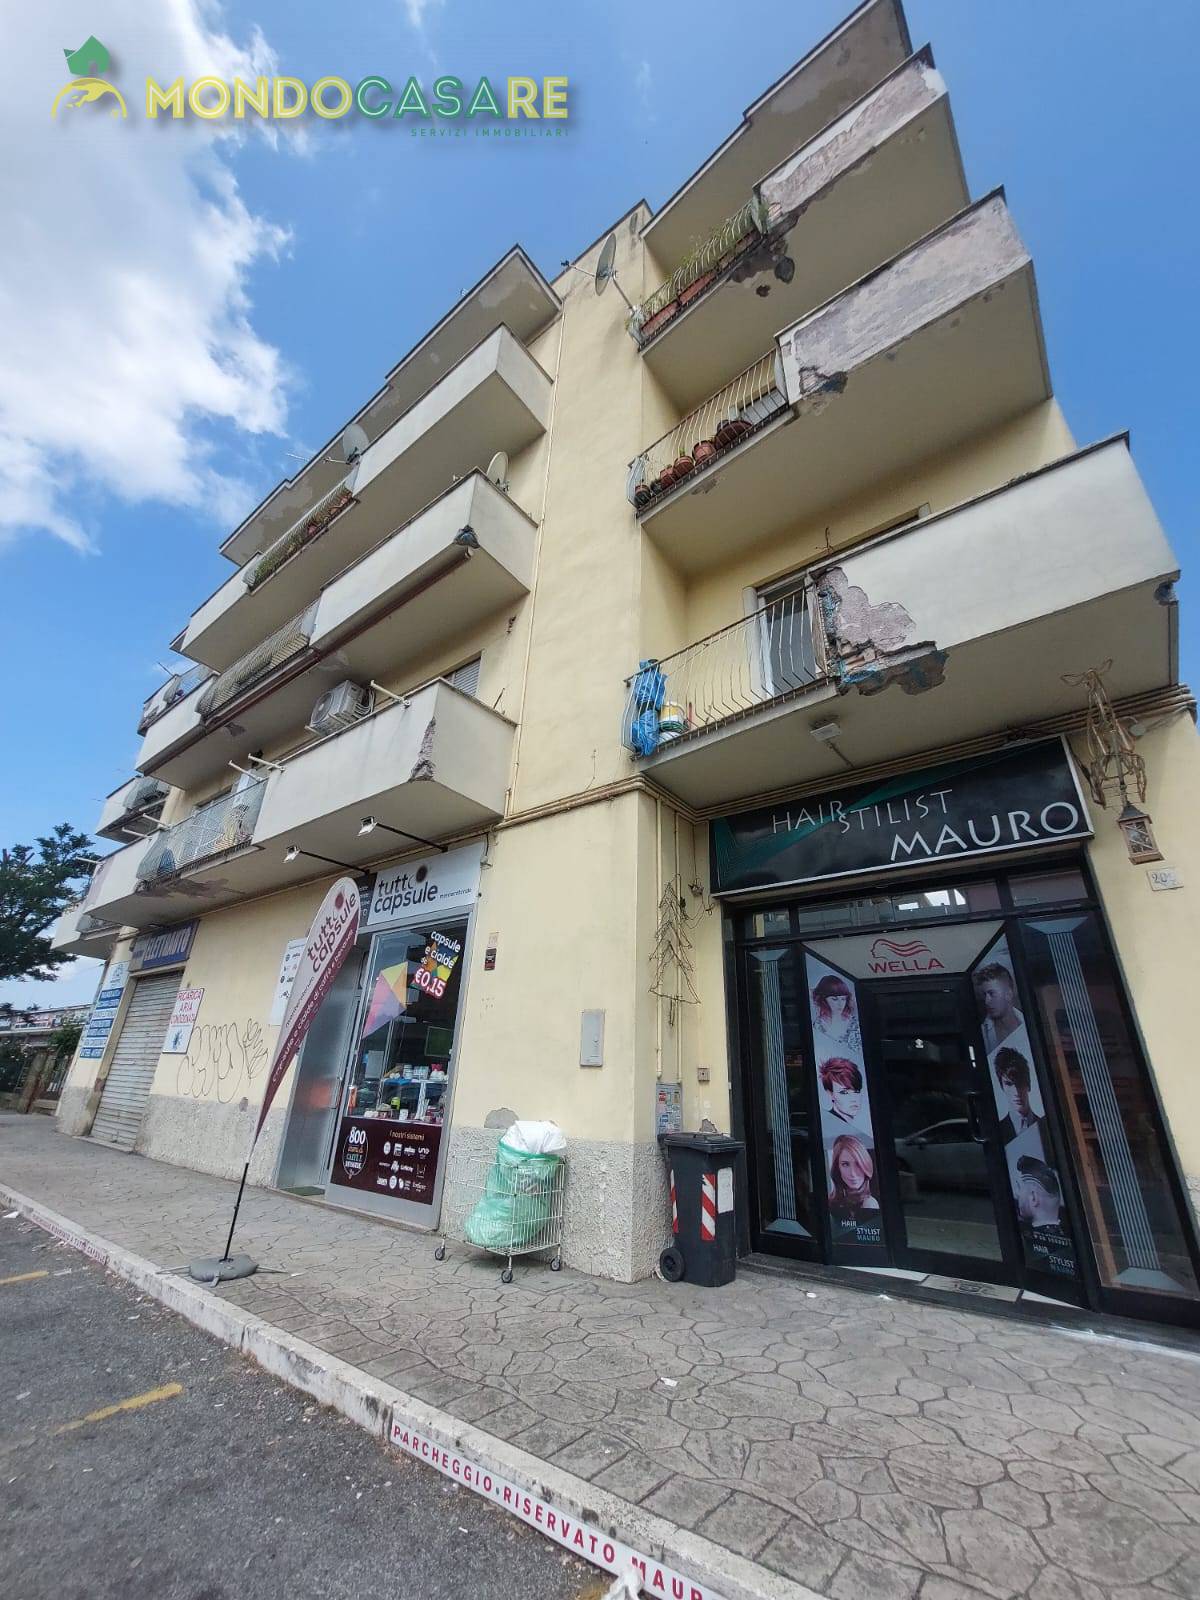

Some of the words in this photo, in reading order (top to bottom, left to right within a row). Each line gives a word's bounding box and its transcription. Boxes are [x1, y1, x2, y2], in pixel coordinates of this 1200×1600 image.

[771, 799, 844, 834] HAIR
[839, 788, 953, 834] STILIST
[890, 801, 1079, 861] MAURO
[374, 882, 439, 915] capsule
[312, 892, 356, 973] capsule
[430, 931, 461, 953] capsule
[424, 946, 431, 955] e
[430, 949, 455, 969] cialde
[868, 957, 945, 974] WELLA
[415, 967, 447, 997] €0,15
[348, 1127, 367, 1145] 800
[393, 1424, 492, 1492] PARCHEGGIO
[503, 1485, 616, 1563] RISERVATO
